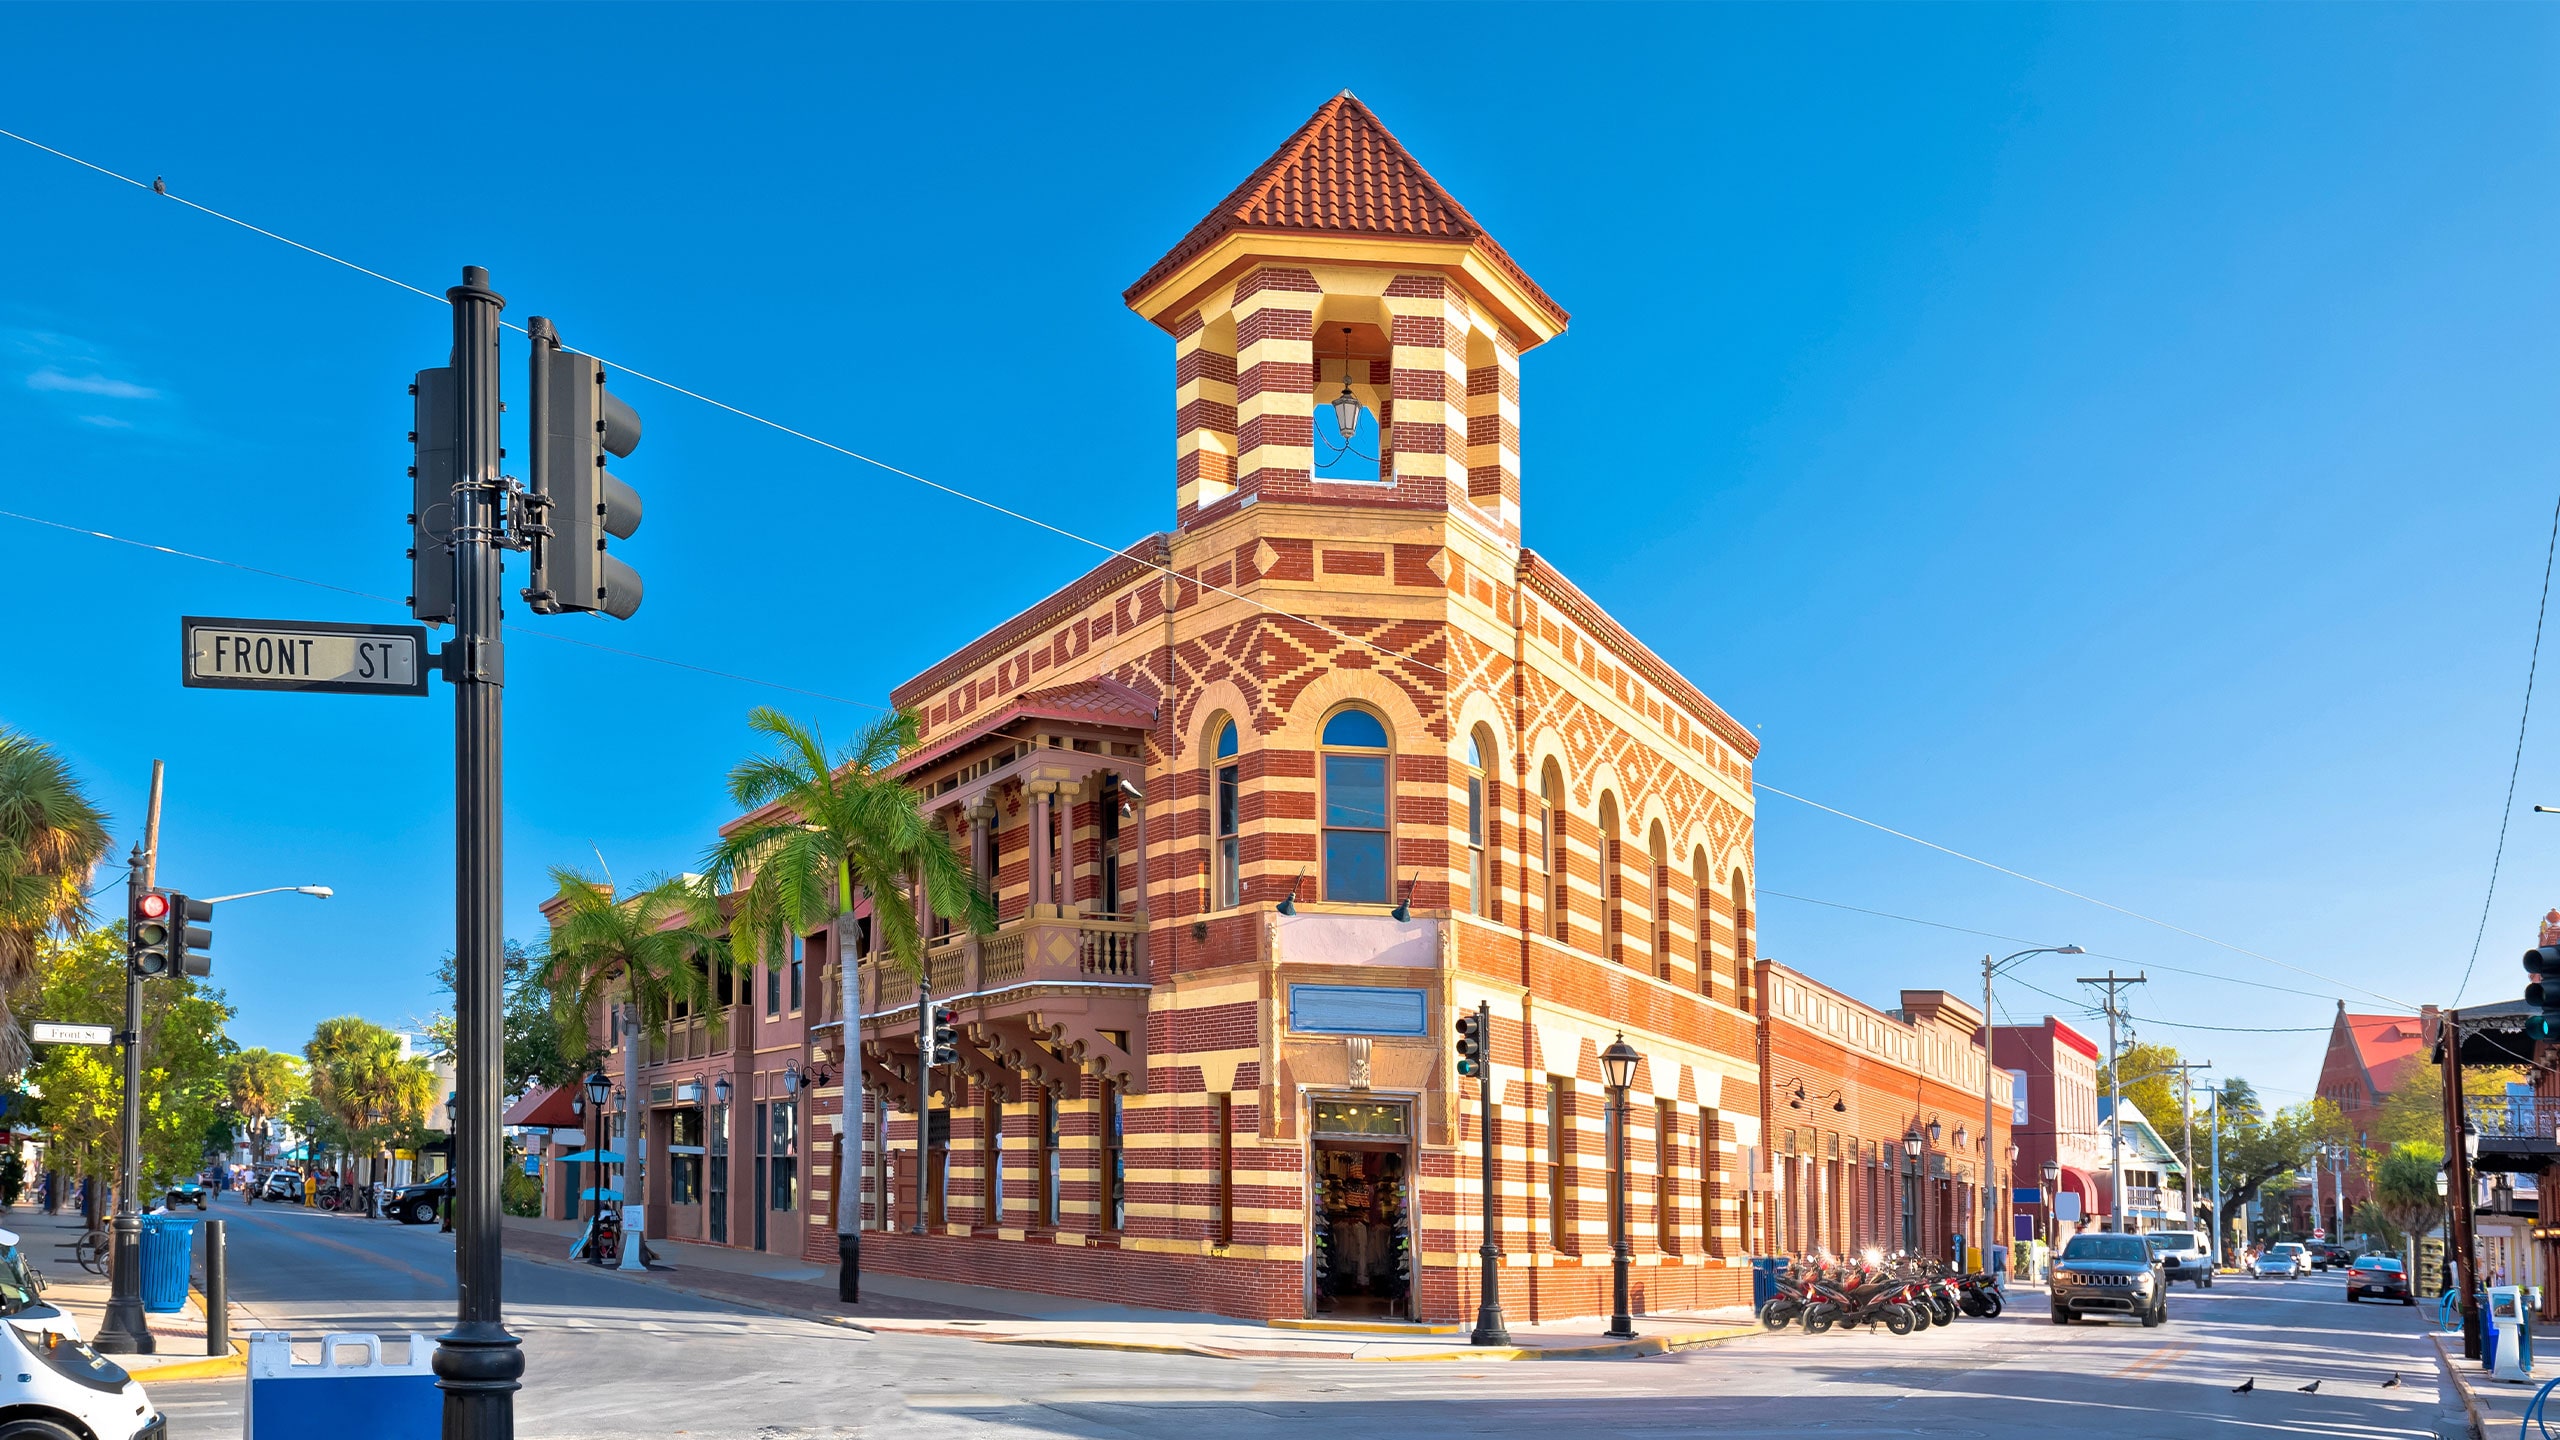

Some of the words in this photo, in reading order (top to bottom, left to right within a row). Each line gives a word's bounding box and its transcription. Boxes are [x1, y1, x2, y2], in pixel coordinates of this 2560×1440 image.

[214, 636, 314, 676] FRONT
[358, 642, 393, 679] ST
[51, 1028, 81, 1039] Front
[84, 1030, 96, 1040] St
